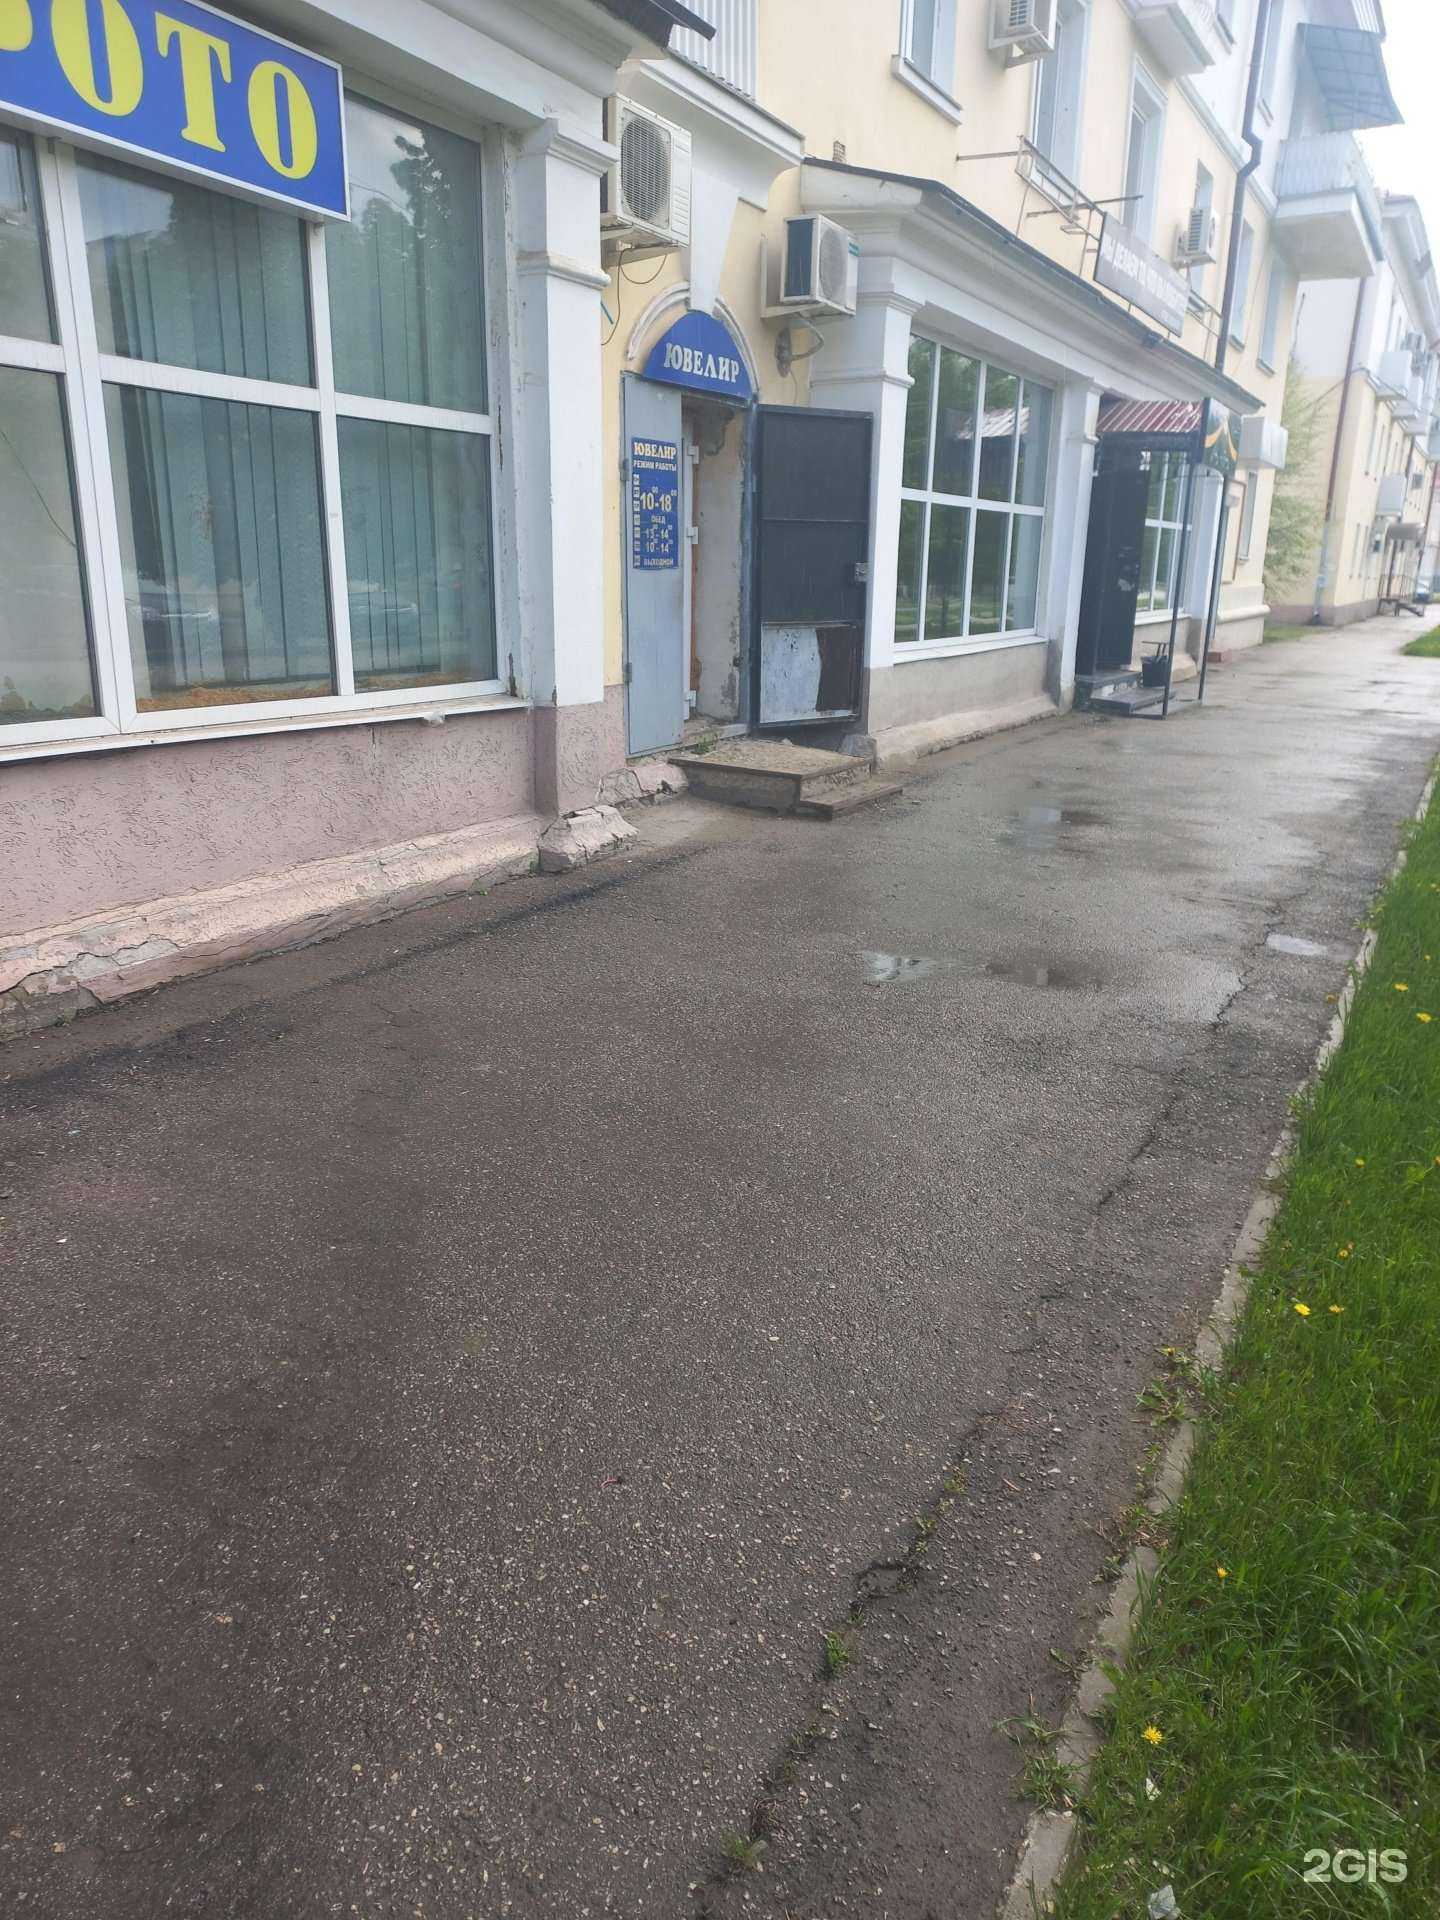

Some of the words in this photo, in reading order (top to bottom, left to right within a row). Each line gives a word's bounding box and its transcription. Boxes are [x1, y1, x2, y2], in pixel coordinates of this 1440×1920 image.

[0, 0, 318, 179] ОТО
[663, 342, 740, 383] ЮВЕЛИР
[633, 442, 677, 459] ЮВЕЛИР
